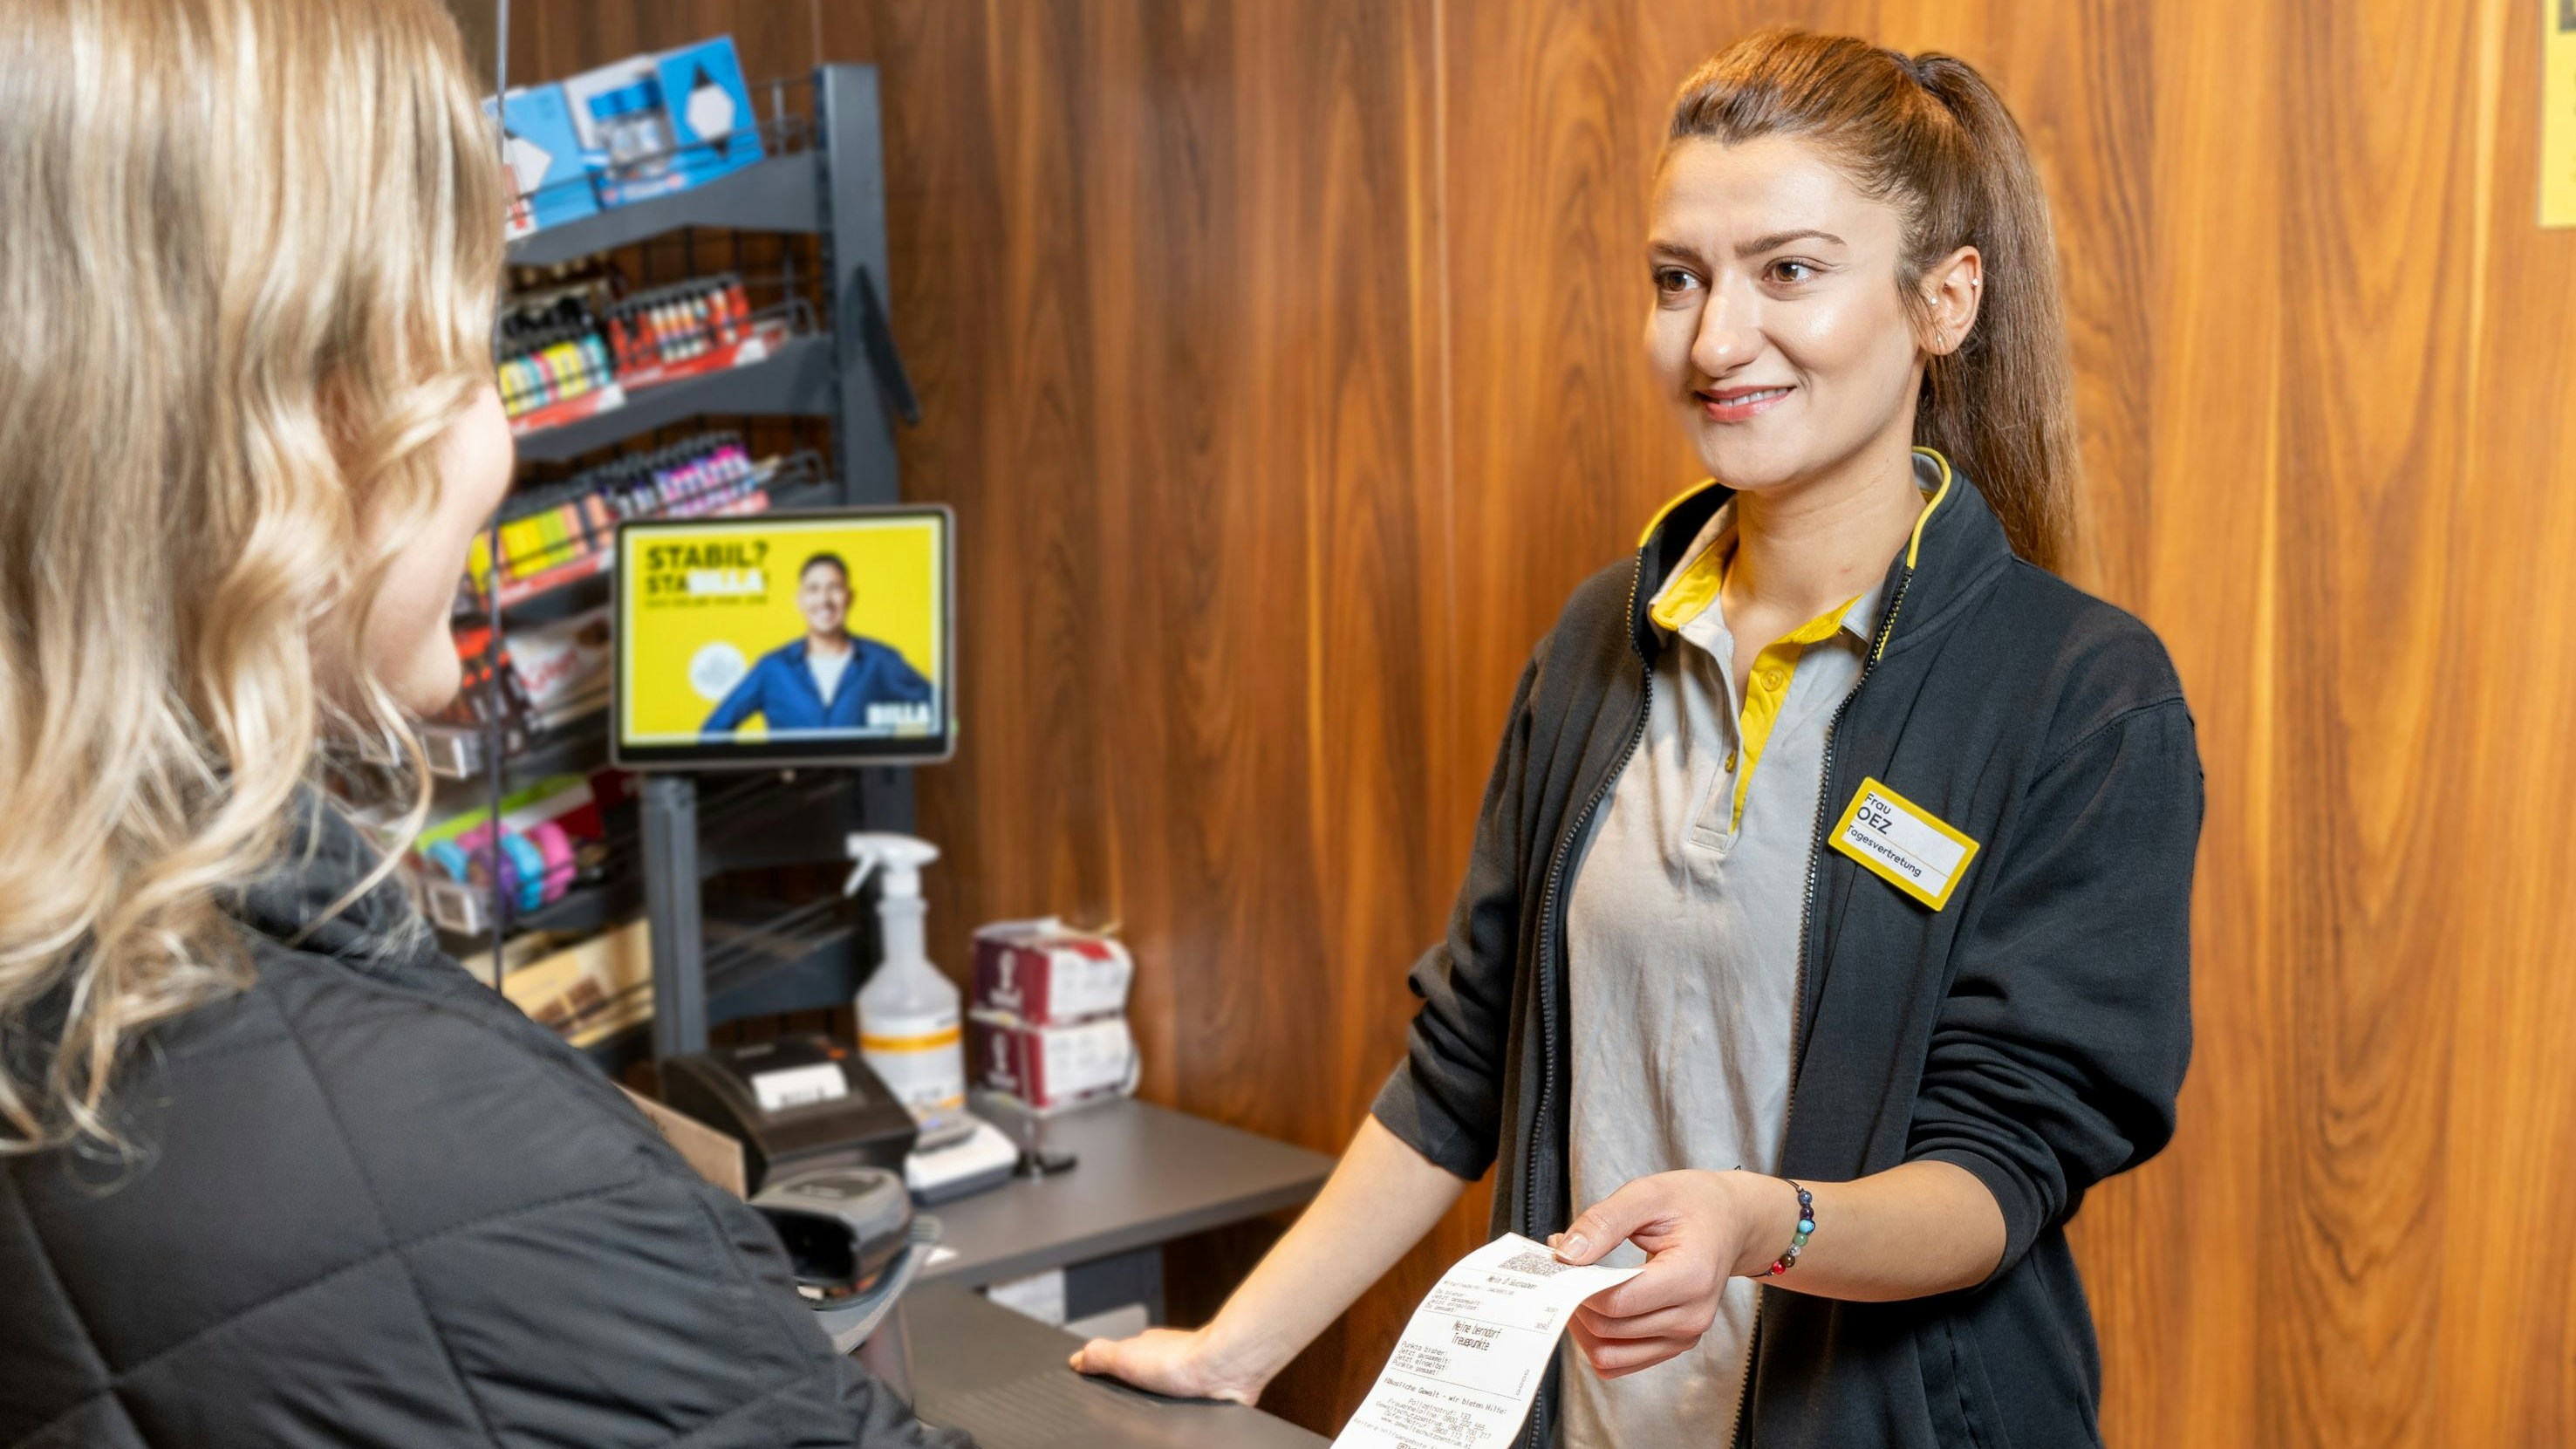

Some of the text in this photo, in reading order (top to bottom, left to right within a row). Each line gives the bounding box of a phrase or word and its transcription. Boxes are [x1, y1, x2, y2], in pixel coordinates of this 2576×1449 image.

[647, 541, 769, 570] STABIL?
[1865, 793, 1891, 815] Frau
[1857, 807, 1893, 835] OEZ
[1847, 824, 1922, 878] Tagesvertretung
[1452, 1320, 1472, 1333] Meine
[1401, 1340, 1423, 1351] Punkte
[1452, 1332, 1490, 1351] Treuepunkte
[1395, 1354, 1412, 1363] Jetzt
[1398, 1348, 1416, 1357] Jetzt
[1392, 1358, 1413, 1370] Punkte
[1418, 1387, 1439, 1398] Gewalt
[1461, 1398, 1484, 1409] bieten
[1485, 1404, 1507, 1415] Hilfe:
[1460, 1412, 1472, 1421] 133
